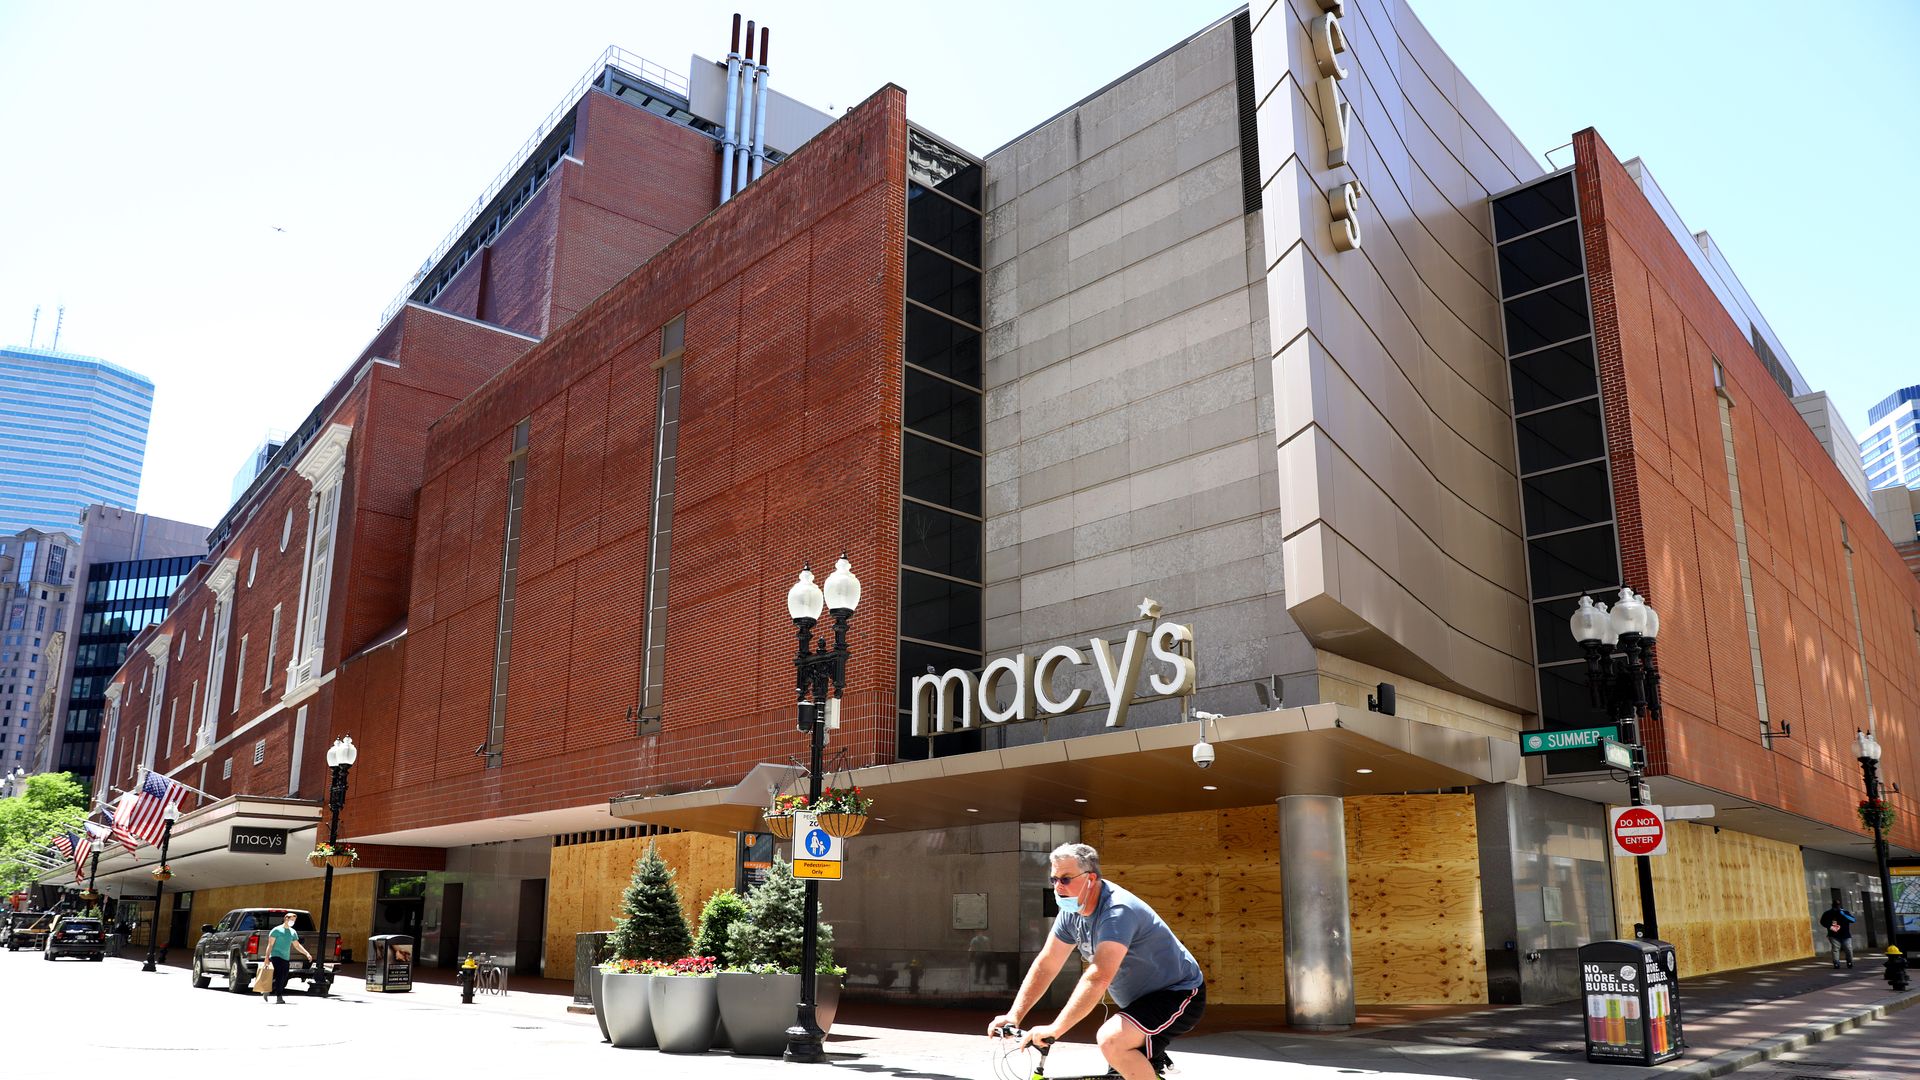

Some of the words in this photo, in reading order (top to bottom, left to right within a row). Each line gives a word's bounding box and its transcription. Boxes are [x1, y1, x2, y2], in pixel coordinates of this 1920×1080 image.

[1548, 730, 1600, 748] SUMMER
[1620, 819, 1633, 827] DO
[1637, 818, 1655, 826] NOT
[235, 833, 282, 849] macy's
[1625, 836, 1654, 845] ENTER
[1584, 964, 1603, 974] NO.
[1585, 973, 1619, 983] MORE.
[1586, 982, 1639, 993] BUBBLES.
